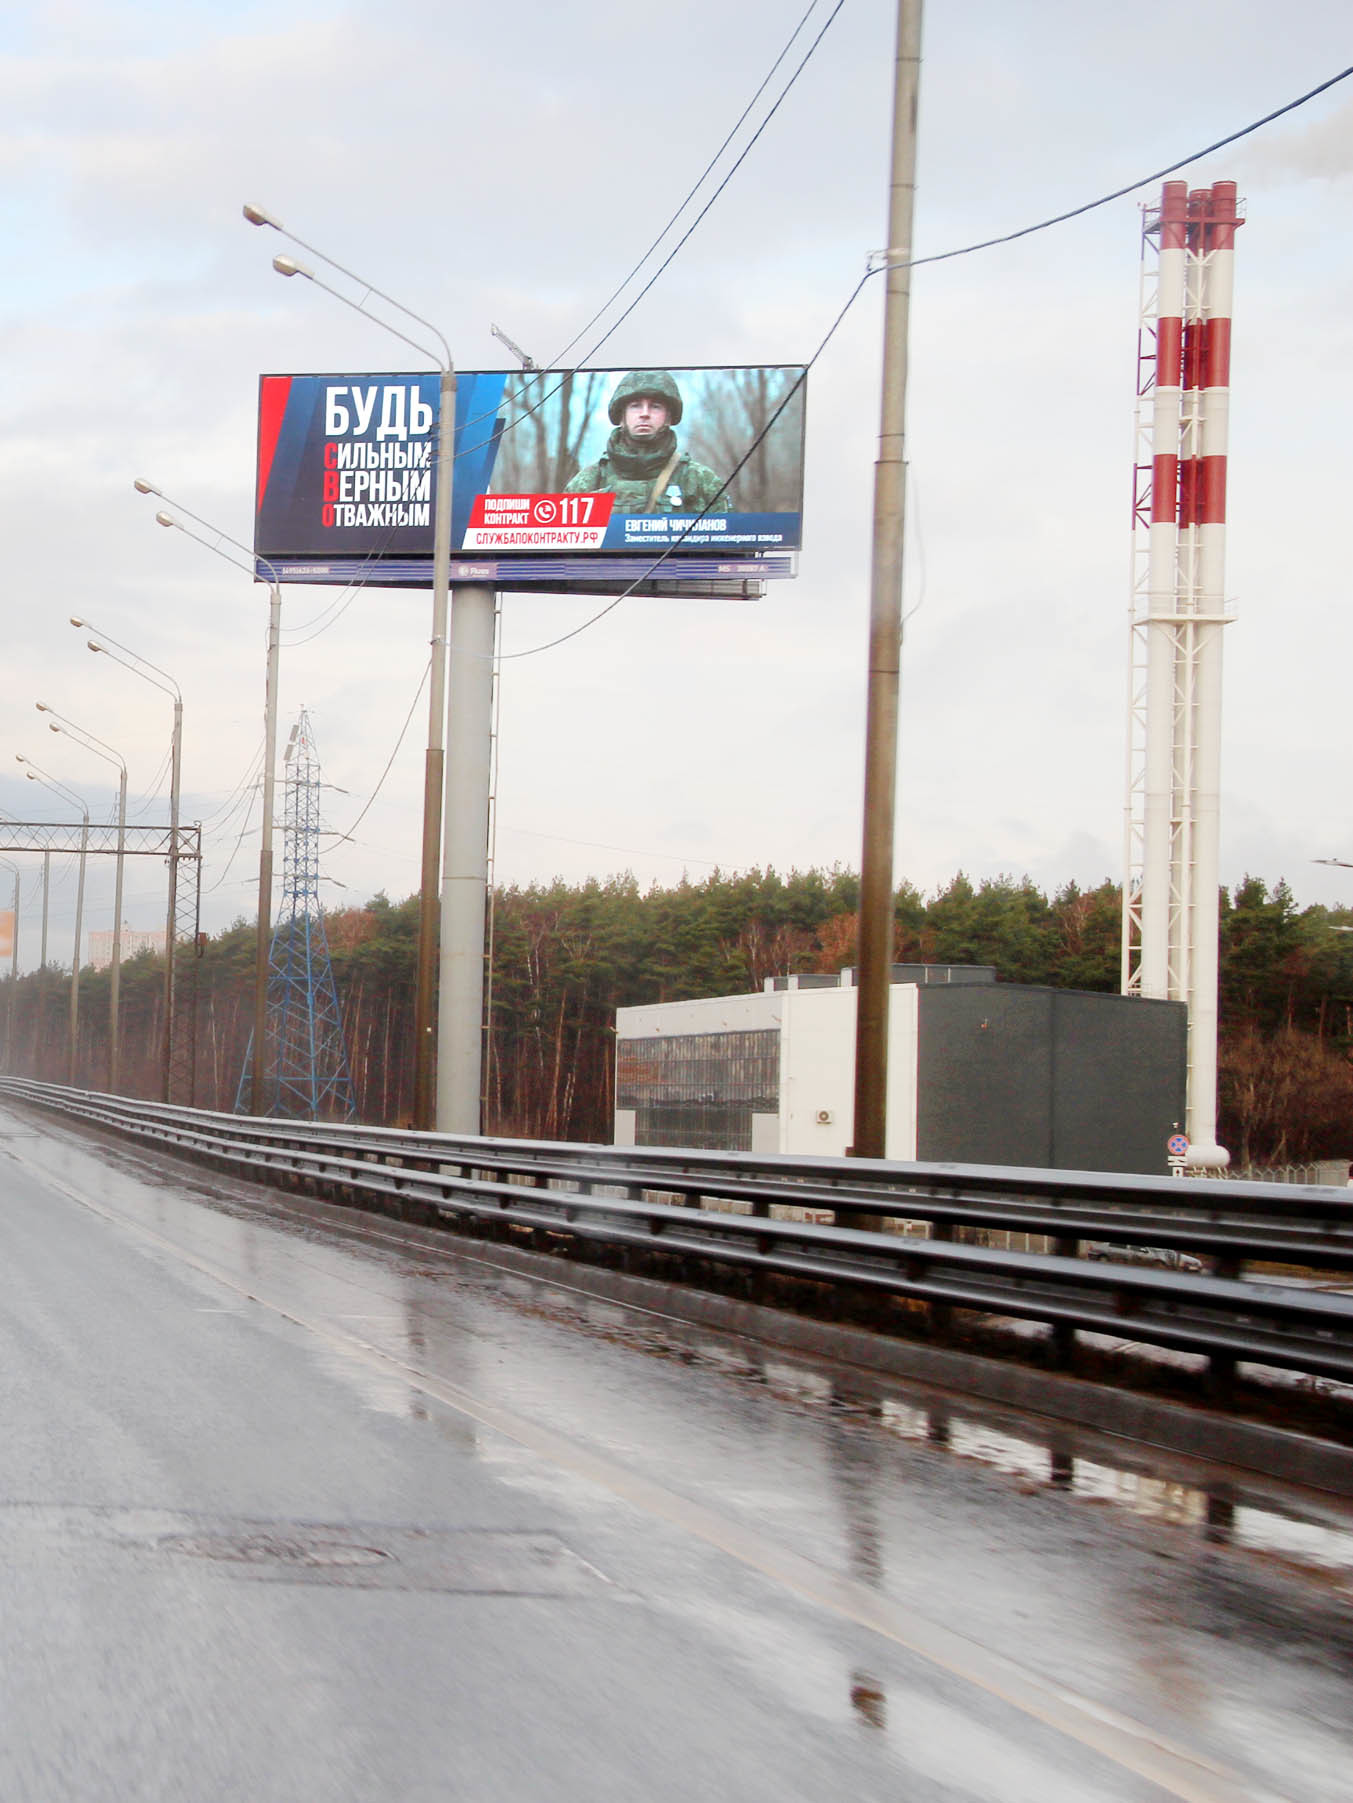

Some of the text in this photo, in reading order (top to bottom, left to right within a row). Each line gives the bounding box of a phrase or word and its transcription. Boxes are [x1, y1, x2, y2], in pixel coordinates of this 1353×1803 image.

[325, 385, 434, 442] БУДЬ
[323, 441, 433, 470] СИЛЬНЫМ
[323, 470, 432, 503] ВЕРНЫМ
[321, 503, 431, 528] ОТВАЖНЫМ
[484, 498, 531, 511] ПОДПИШИ
[559, 497, 595, 524] 117
[484, 512, 530, 525] КОНТРАКТ
[624, 516, 668, 532] ЕВГЕНИЙ
[476, 531, 599, 545] СЛУЖБАПОКОНТРАКТУ.РФ
